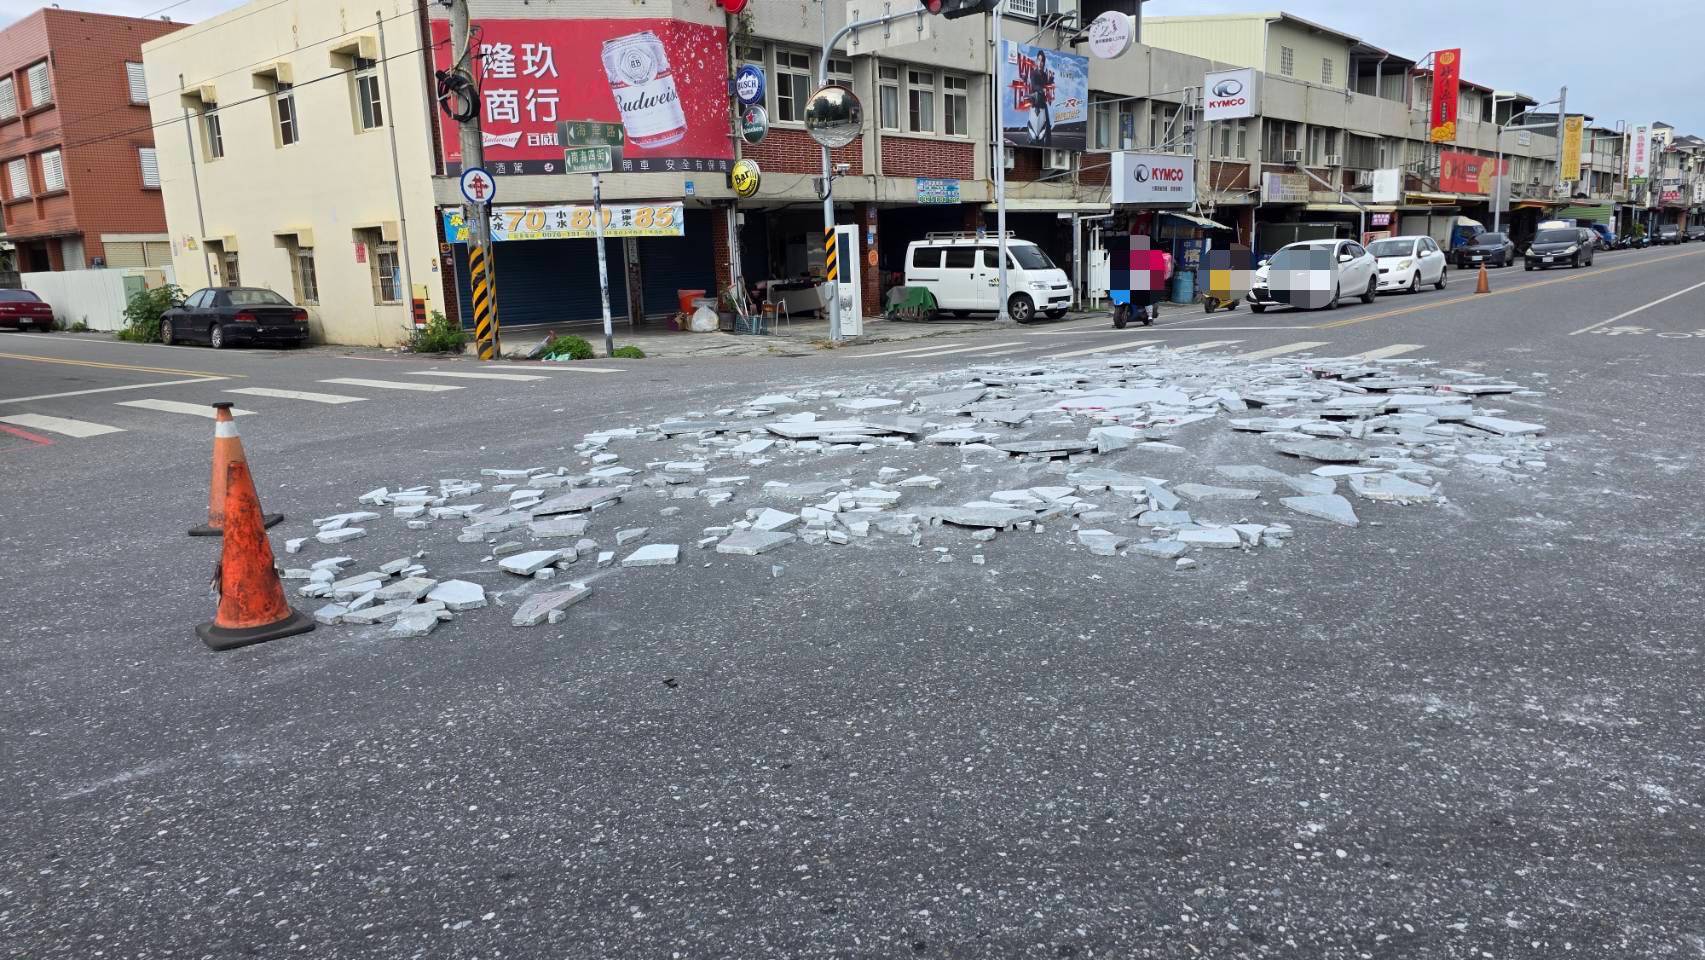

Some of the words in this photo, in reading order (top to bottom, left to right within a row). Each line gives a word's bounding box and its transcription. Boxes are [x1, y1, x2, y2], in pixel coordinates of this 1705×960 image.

[484, 88, 560, 124] 商行
[1209, 97, 1246, 109] KYMCO
[735, 170, 751, 185] Bar
[1151, 167, 1184, 181] KYMCO
[634, 207, 674, 228] 85
